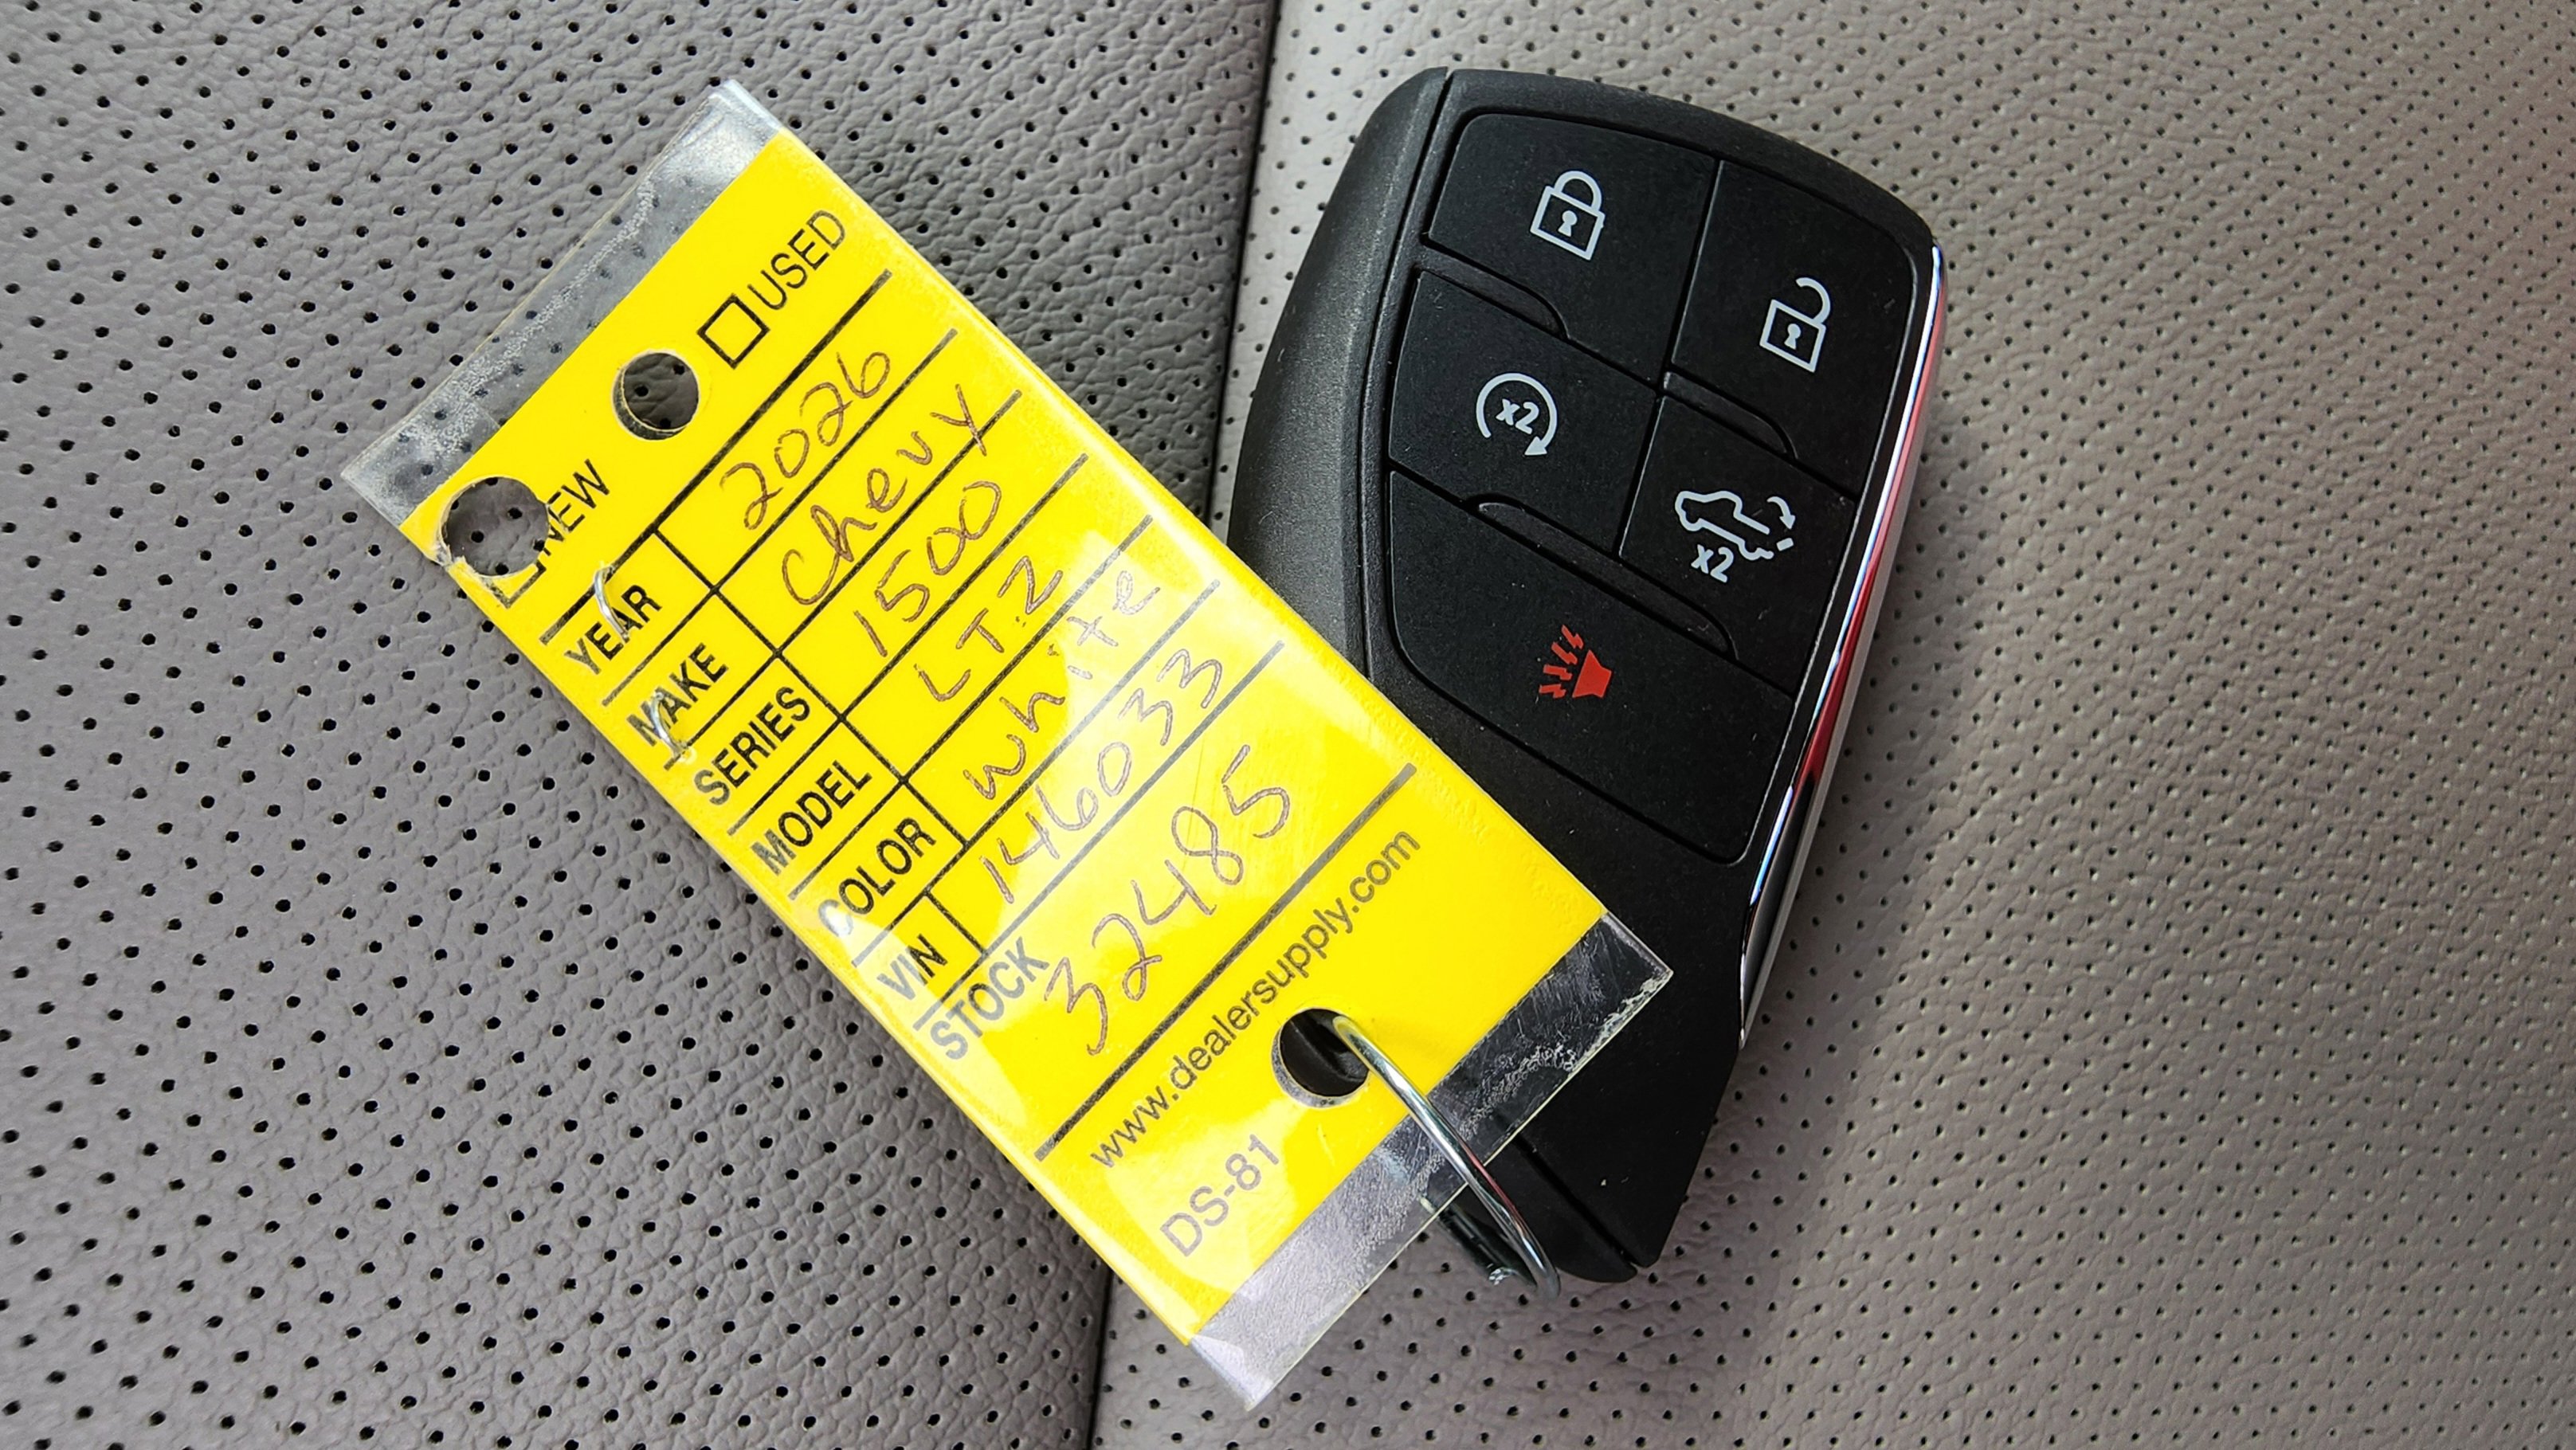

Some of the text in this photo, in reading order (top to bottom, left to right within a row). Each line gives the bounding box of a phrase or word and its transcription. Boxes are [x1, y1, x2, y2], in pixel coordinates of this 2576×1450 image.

[747, 209, 847, 312] USED
[720, 351, 891, 530] 2026
[1496, 398, 1541, 435] x2
[853, 480, 1002, 657] 1500
[1690, 544, 1735, 583] x2
[564, 585, 661, 675] YEAR
[626, 642, 729, 747] MAKE
[694, 686, 810, 806] SERIES
[750, 759, 872, 876] MODEL
[978, 649, 1224, 904] 146033
[818, 817, 938, 938] COLOR
[1045, 744, 1291, 1056] 32485
[876, 933, 947, 1001] VIN
[931, 936, 1049, 1061] STOCK
[1091, 830, 1421, 1168] www.dealersupply.com
[1159, 1135, 1280, 1257] DS-81
